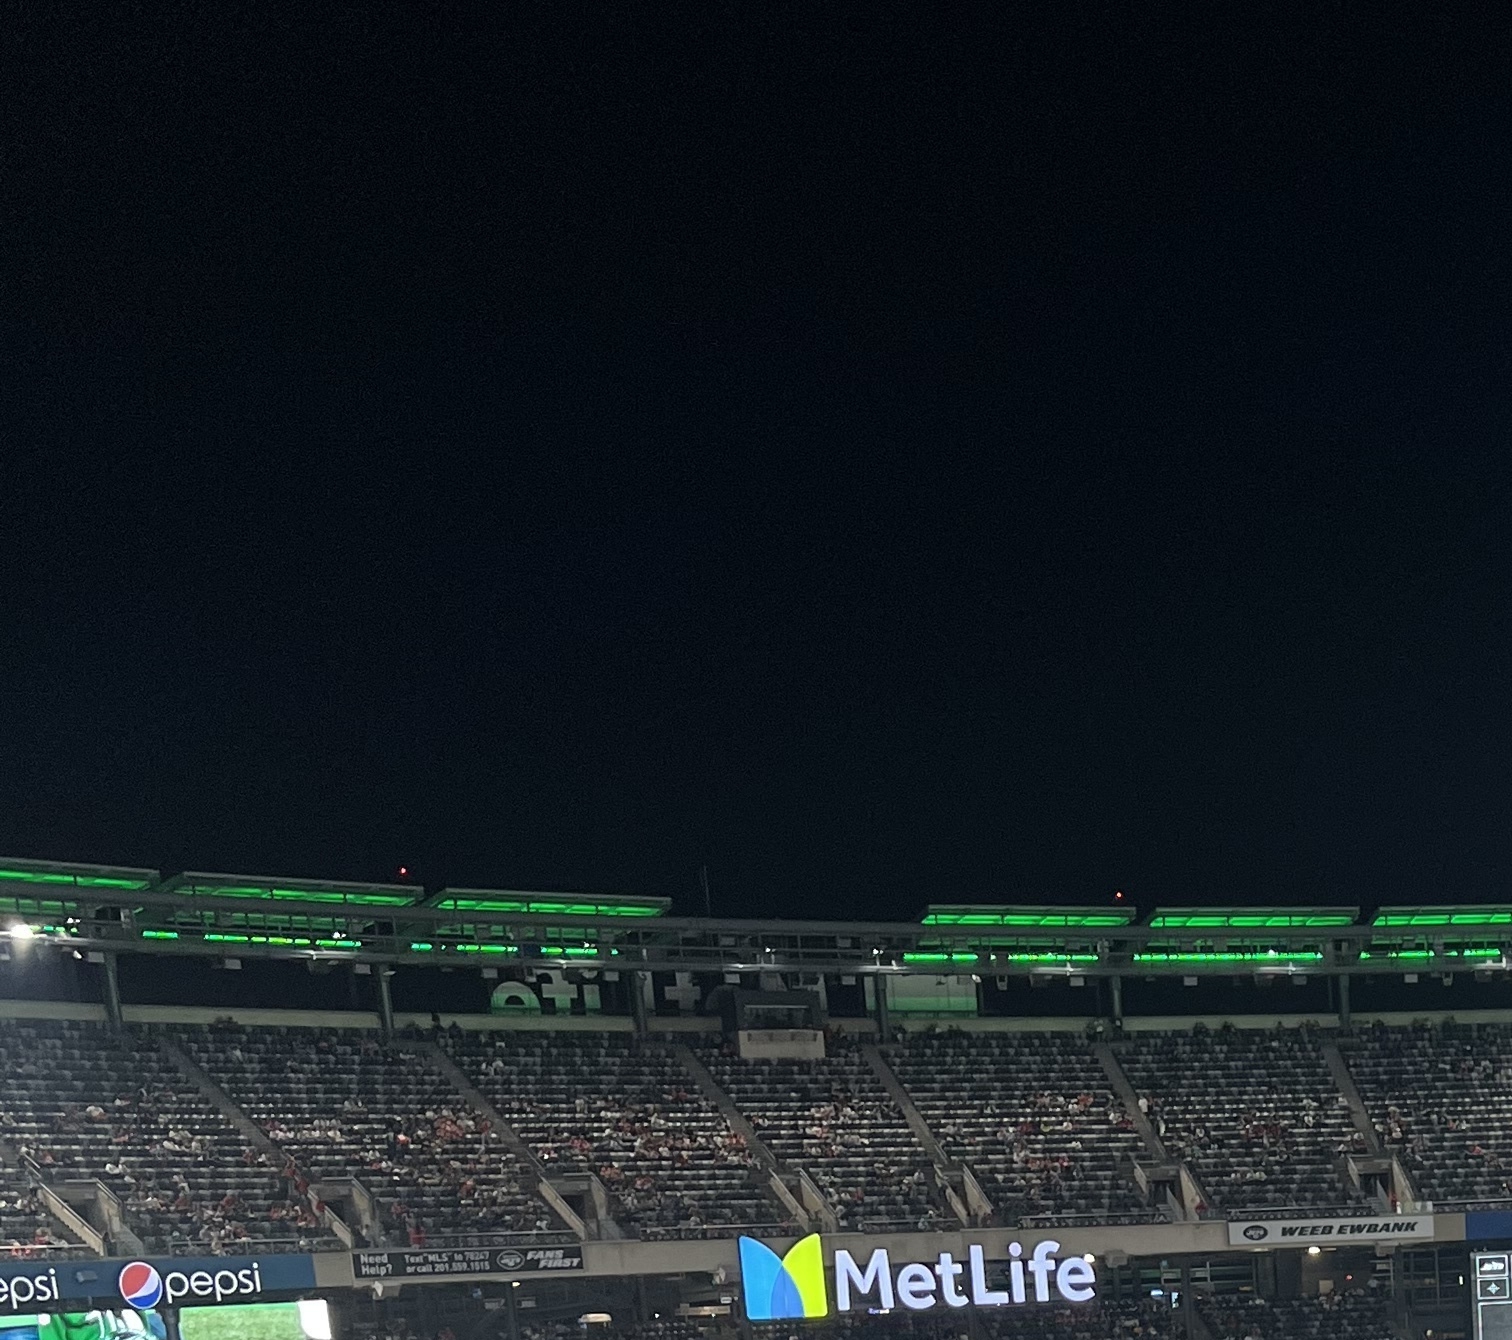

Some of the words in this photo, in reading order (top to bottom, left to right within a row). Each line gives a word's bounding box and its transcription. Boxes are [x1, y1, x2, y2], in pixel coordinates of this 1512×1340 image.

[1281, 1225, 1334, 1237] WEEB
[1336, 1222, 1418, 1235] EWBANK
[360, 1253, 388, 1265] Need
[404, 1254, 424, 1264] Text
[526, 1250, 563, 1260] FANS
[406, 1265, 416, 1273] or
[417, 1264, 433, 1273] call
[538, 1258, 581, 1268] FIRST
[361, 1263, 393, 1276] Help?
[836, 1240, 1095, 1312] MetLife
[164, 1262, 263, 1303] pepsi
